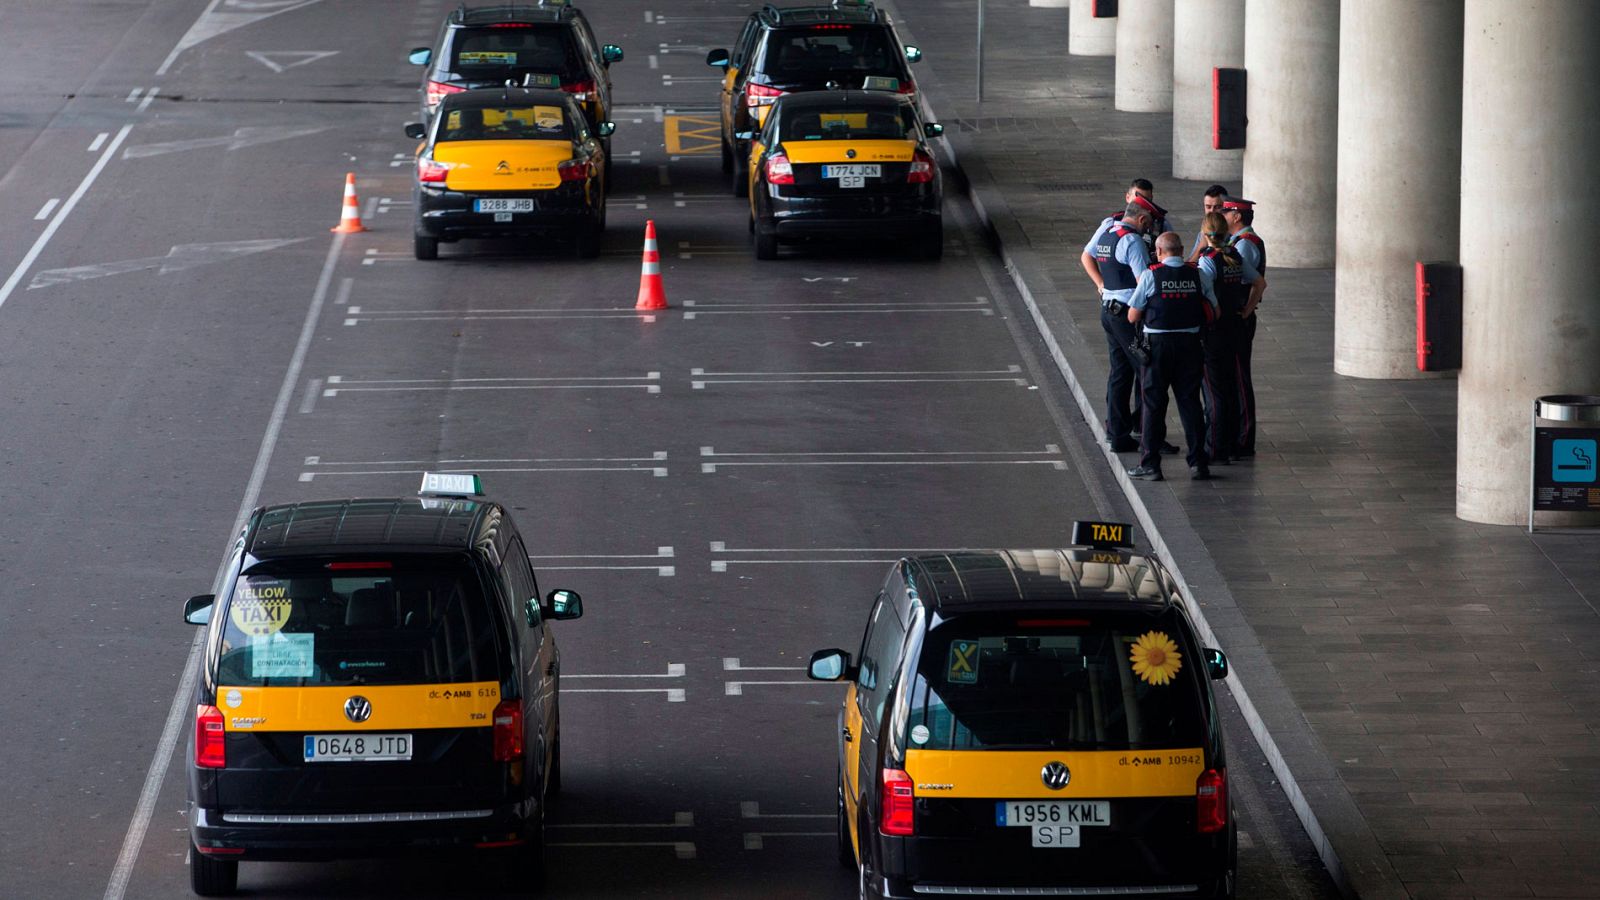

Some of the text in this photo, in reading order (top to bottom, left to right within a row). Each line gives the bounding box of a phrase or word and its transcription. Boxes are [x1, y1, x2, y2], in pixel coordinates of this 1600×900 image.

[830, 166, 878, 176] 1774 JCN
[843, 177, 861, 186] SP
[482, 200, 531, 209] 3288 JHB
[1162, 281, 1196, 289] POLICIA
[440, 476, 464, 489] TAXI
[1091, 524, 1122, 541] TAXI
[238, 587, 285, 599] YELLOW
[240, 606, 282, 622] TAXI
[478, 688, 497, 697] 616
[318, 737, 408, 755] 0648 JTD
[1142, 757, 1162, 765] AMB
[1168, 755, 1201, 765] 10942
[1014, 804, 1105, 822] 1956 KML
[1038, 826, 1074, 844] SP
